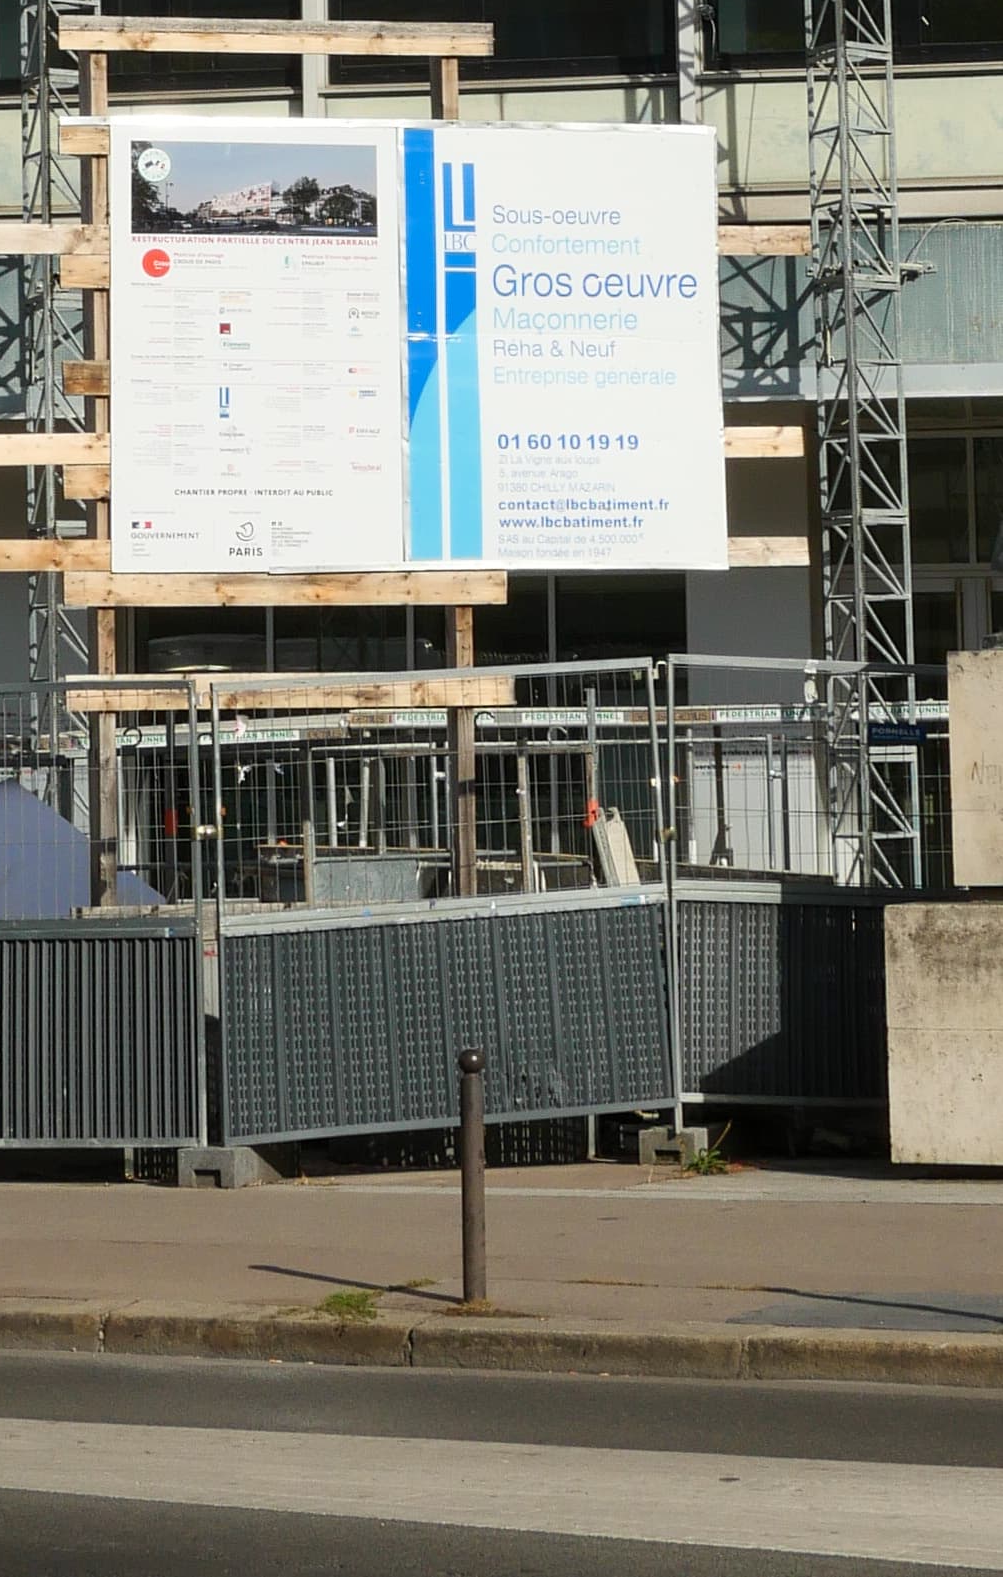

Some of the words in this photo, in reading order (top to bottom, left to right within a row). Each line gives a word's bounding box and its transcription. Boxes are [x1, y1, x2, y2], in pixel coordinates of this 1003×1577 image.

[492, 204, 621, 225] Sous-oeuvre
[132, 235, 214, 244] RESTRUCTURATION
[216, 237, 259, 245] PARTIELLE
[262, 238, 275, 246] DU
[277, 238, 309, 246] CENTRE
[312, 238, 333, 247] JEAN
[443, 233, 477, 251] LBC
[491, 233, 641, 255] Confortement
[492, 264, 573, 298] Gros
[493, 307, 638, 335] Maçonnerie
[549, 340, 564, 358] &
[570, 340, 617, 358] Neuf
[494, 366, 589, 388] Entreprise
[497, 433, 521, 450] 01
[527, 433, 552, 450] 60
[557, 433, 581, 450] 10
[587, 433, 610, 450] 19
[616, 434, 639, 450] 19
[293, 489, 304, 497] AU
[498, 498, 670, 512] contact@lbcbatiment.fr
[499, 516, 644, 528] www.lbcbatiment.fr
[131, 532, 199, 540] GOUVERNEMENT
[228, 546, 264, 557] PARIS
[397, 712, 446, 721] PEDESTRIA
